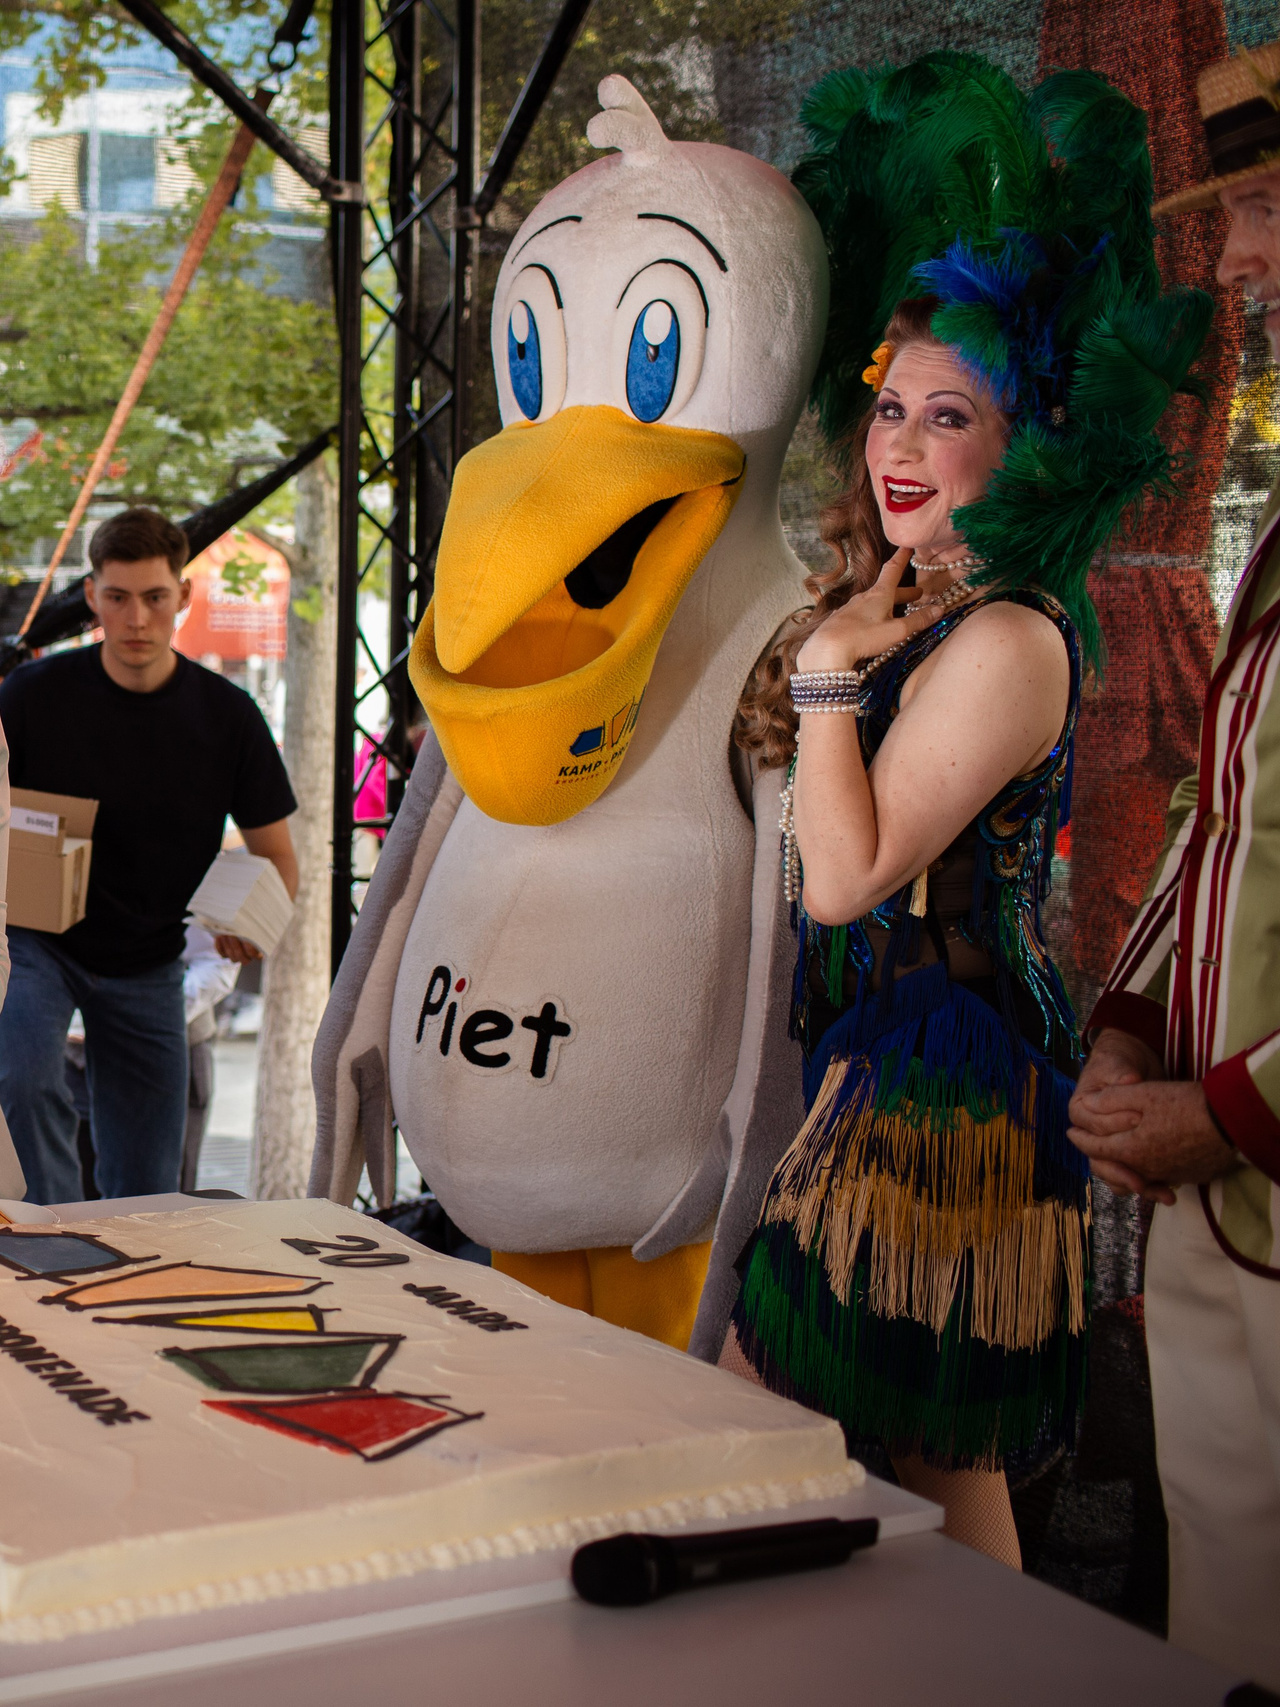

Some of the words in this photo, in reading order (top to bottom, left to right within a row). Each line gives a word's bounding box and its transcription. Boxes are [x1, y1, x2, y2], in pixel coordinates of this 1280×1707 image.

[558, 760, 602, 776] KAMP
[416, 965, 571, 1078] Piet
[280, 1234, 410, 1267] 20
[403, 1282, 529, 1332] JAHRE
